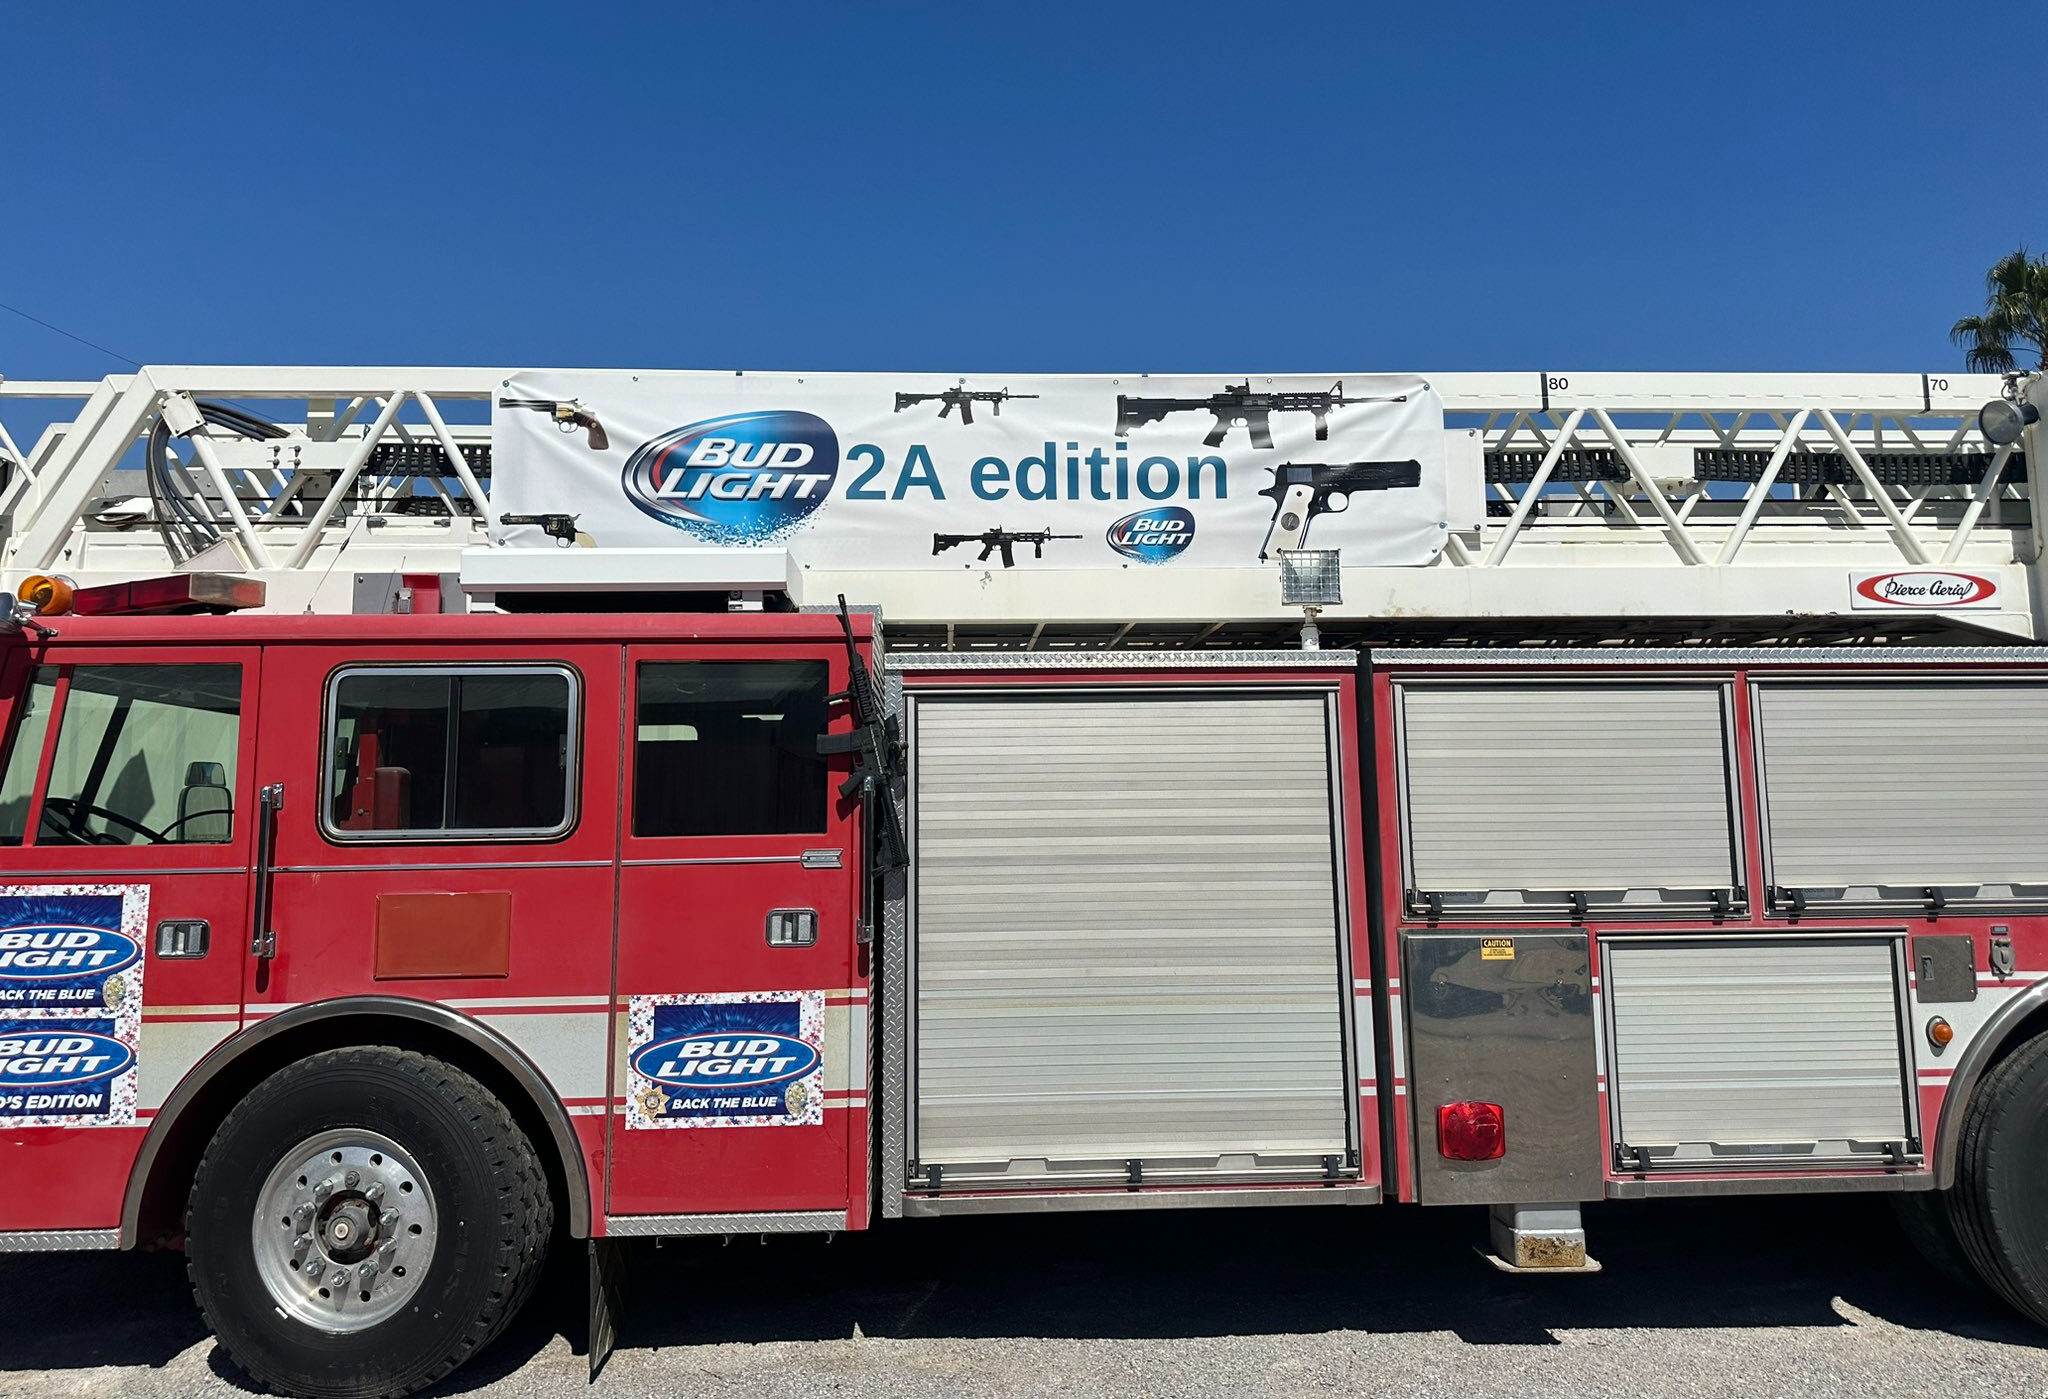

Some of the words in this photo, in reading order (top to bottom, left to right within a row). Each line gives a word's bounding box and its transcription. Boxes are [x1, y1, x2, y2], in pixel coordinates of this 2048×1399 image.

[1549, 377, 1568, 390] 80
[1930, 379, 1948, 391] 70
[686, 437, 814, 469] BUD
[845, 444, 946, 500] 2A
[970, 442, 1228, 501] edition
[657, 467, 832, 500] LIGHT
[1132, 519, 1185, 531] BUD
[1120, 532, 1192, 545] LIGHT
[1885, 577, 1926, 598] Pierce
[1929, 580, 1973, 599] Aerial
[0, 933, 100, 948] BUD
[1483, 939, 1511, 947] CAUTION
[0, 950, 117, 967] IGHT
[0, 990, 26, 1000] ACK
[28, 989, 56, 1000] THE
[58, 989, 95, 1000] BLUE
[0, 1038, 94, 1055] BUD
[677, 1039, 780, 1058] BUD
[0, 1056, 111, 1073] IGHT
[656, 1057, 797, 1077] LIGHT
[25, 1094, 102, 1109] EDITION
[672, 1099, 709, 1109] BACK
[712, 1098, 740, 1108] THE
[742, 1097, 777, 1107] BLUE
